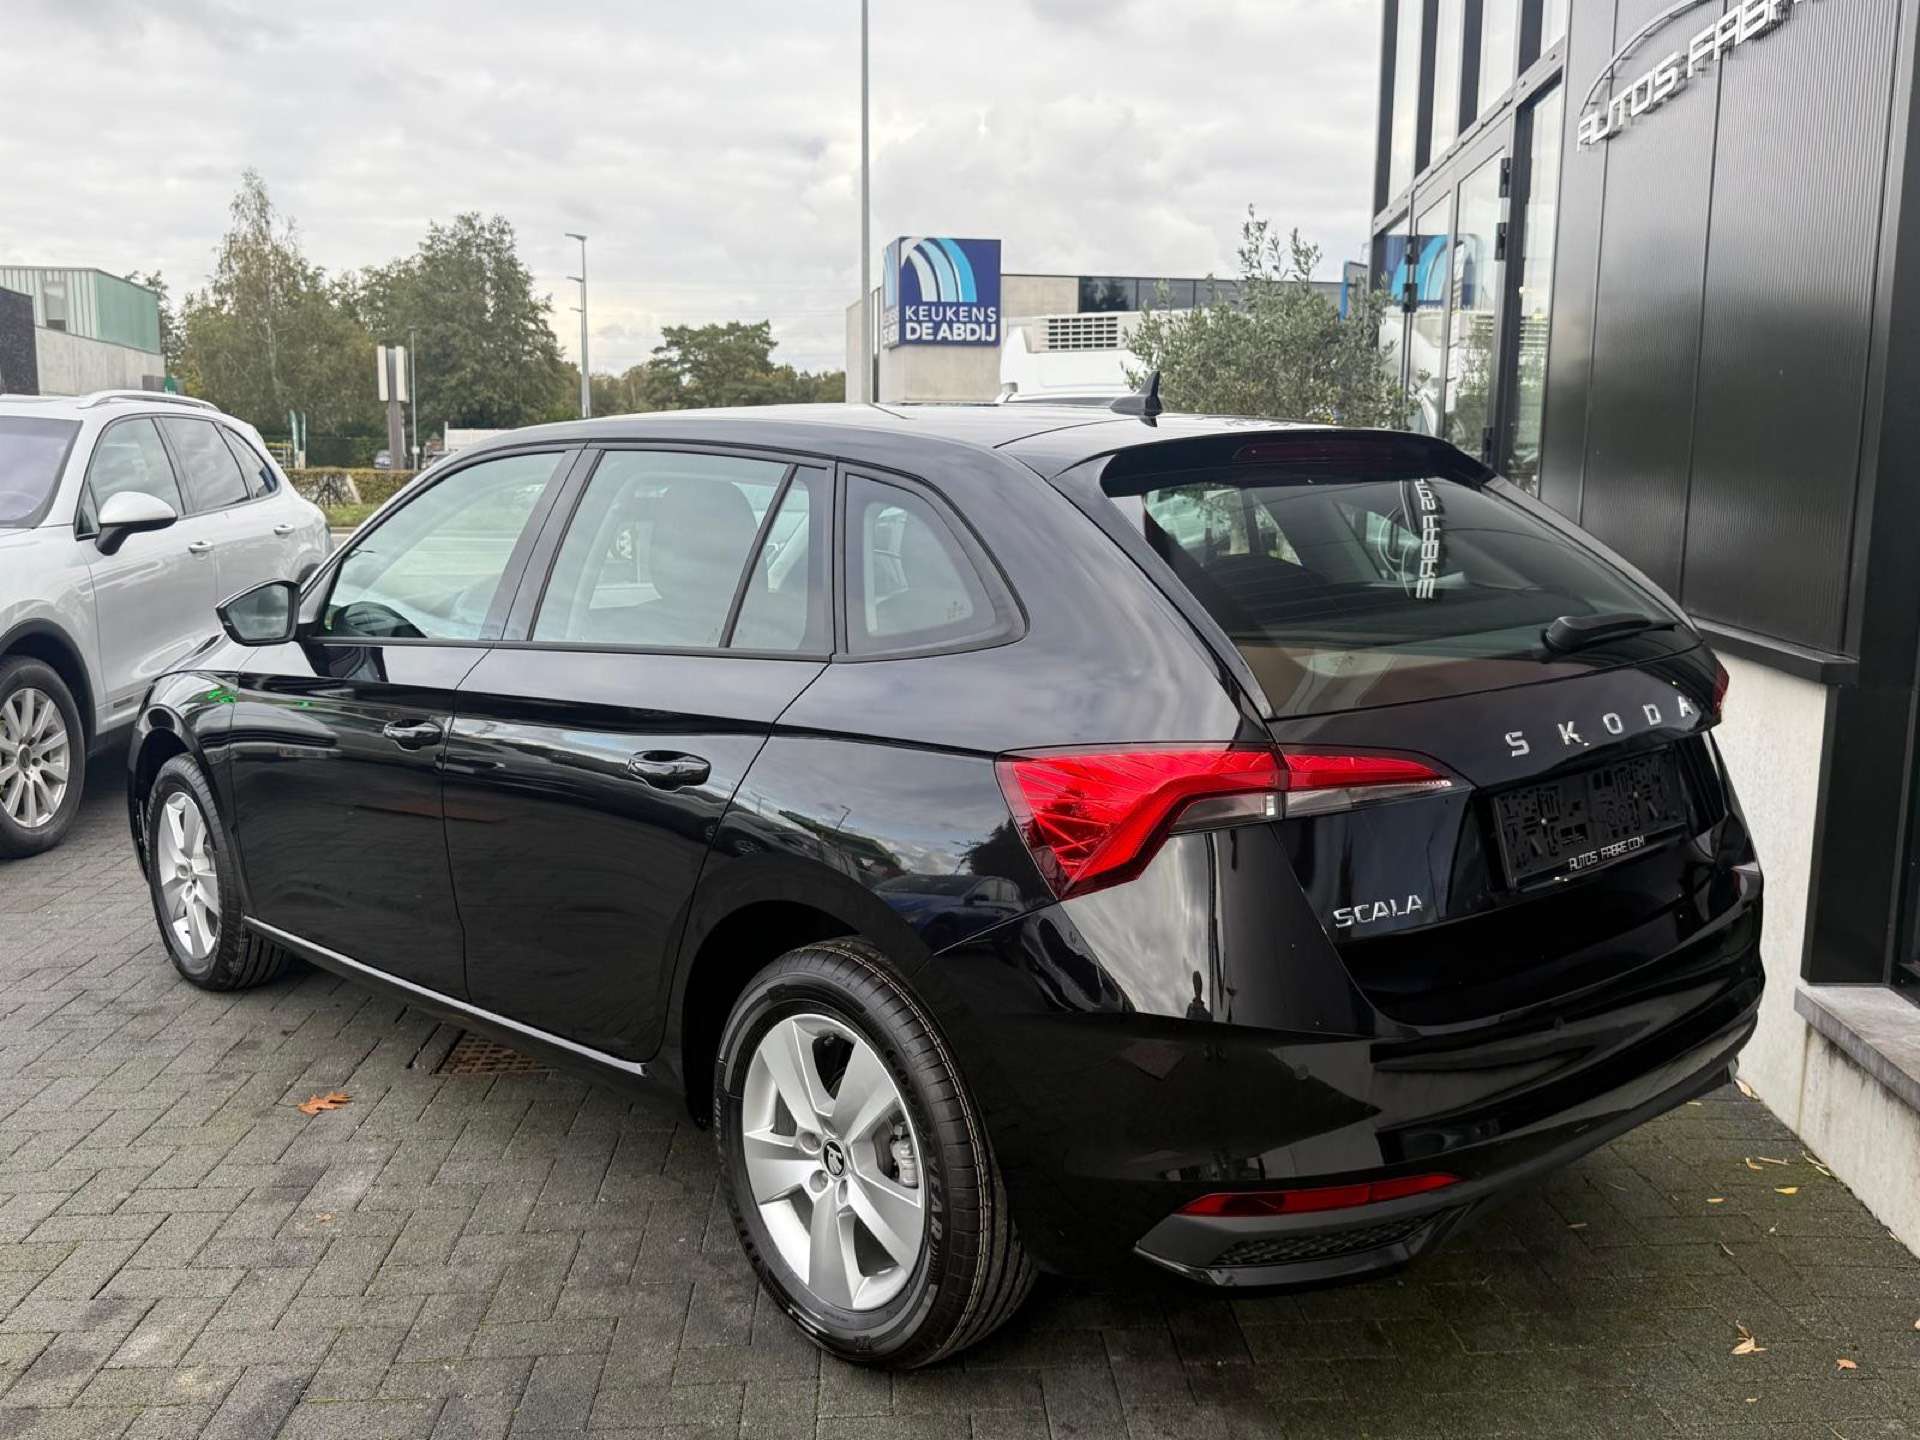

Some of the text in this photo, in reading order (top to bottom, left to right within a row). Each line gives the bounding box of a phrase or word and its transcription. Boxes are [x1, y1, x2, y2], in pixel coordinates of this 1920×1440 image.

[1577, 51, 1680, 151] AUTOS
[905, 305, 997, 322] KEUKENS
[905, 321, 934, 341] DE
[936, 322, 997, 342] ABDIJ
[1504, 695, 1695, 757] SKODA
[1568, 850, 1598, 872] AUTOS
[1332, 894, 1424, 928] SCALA
